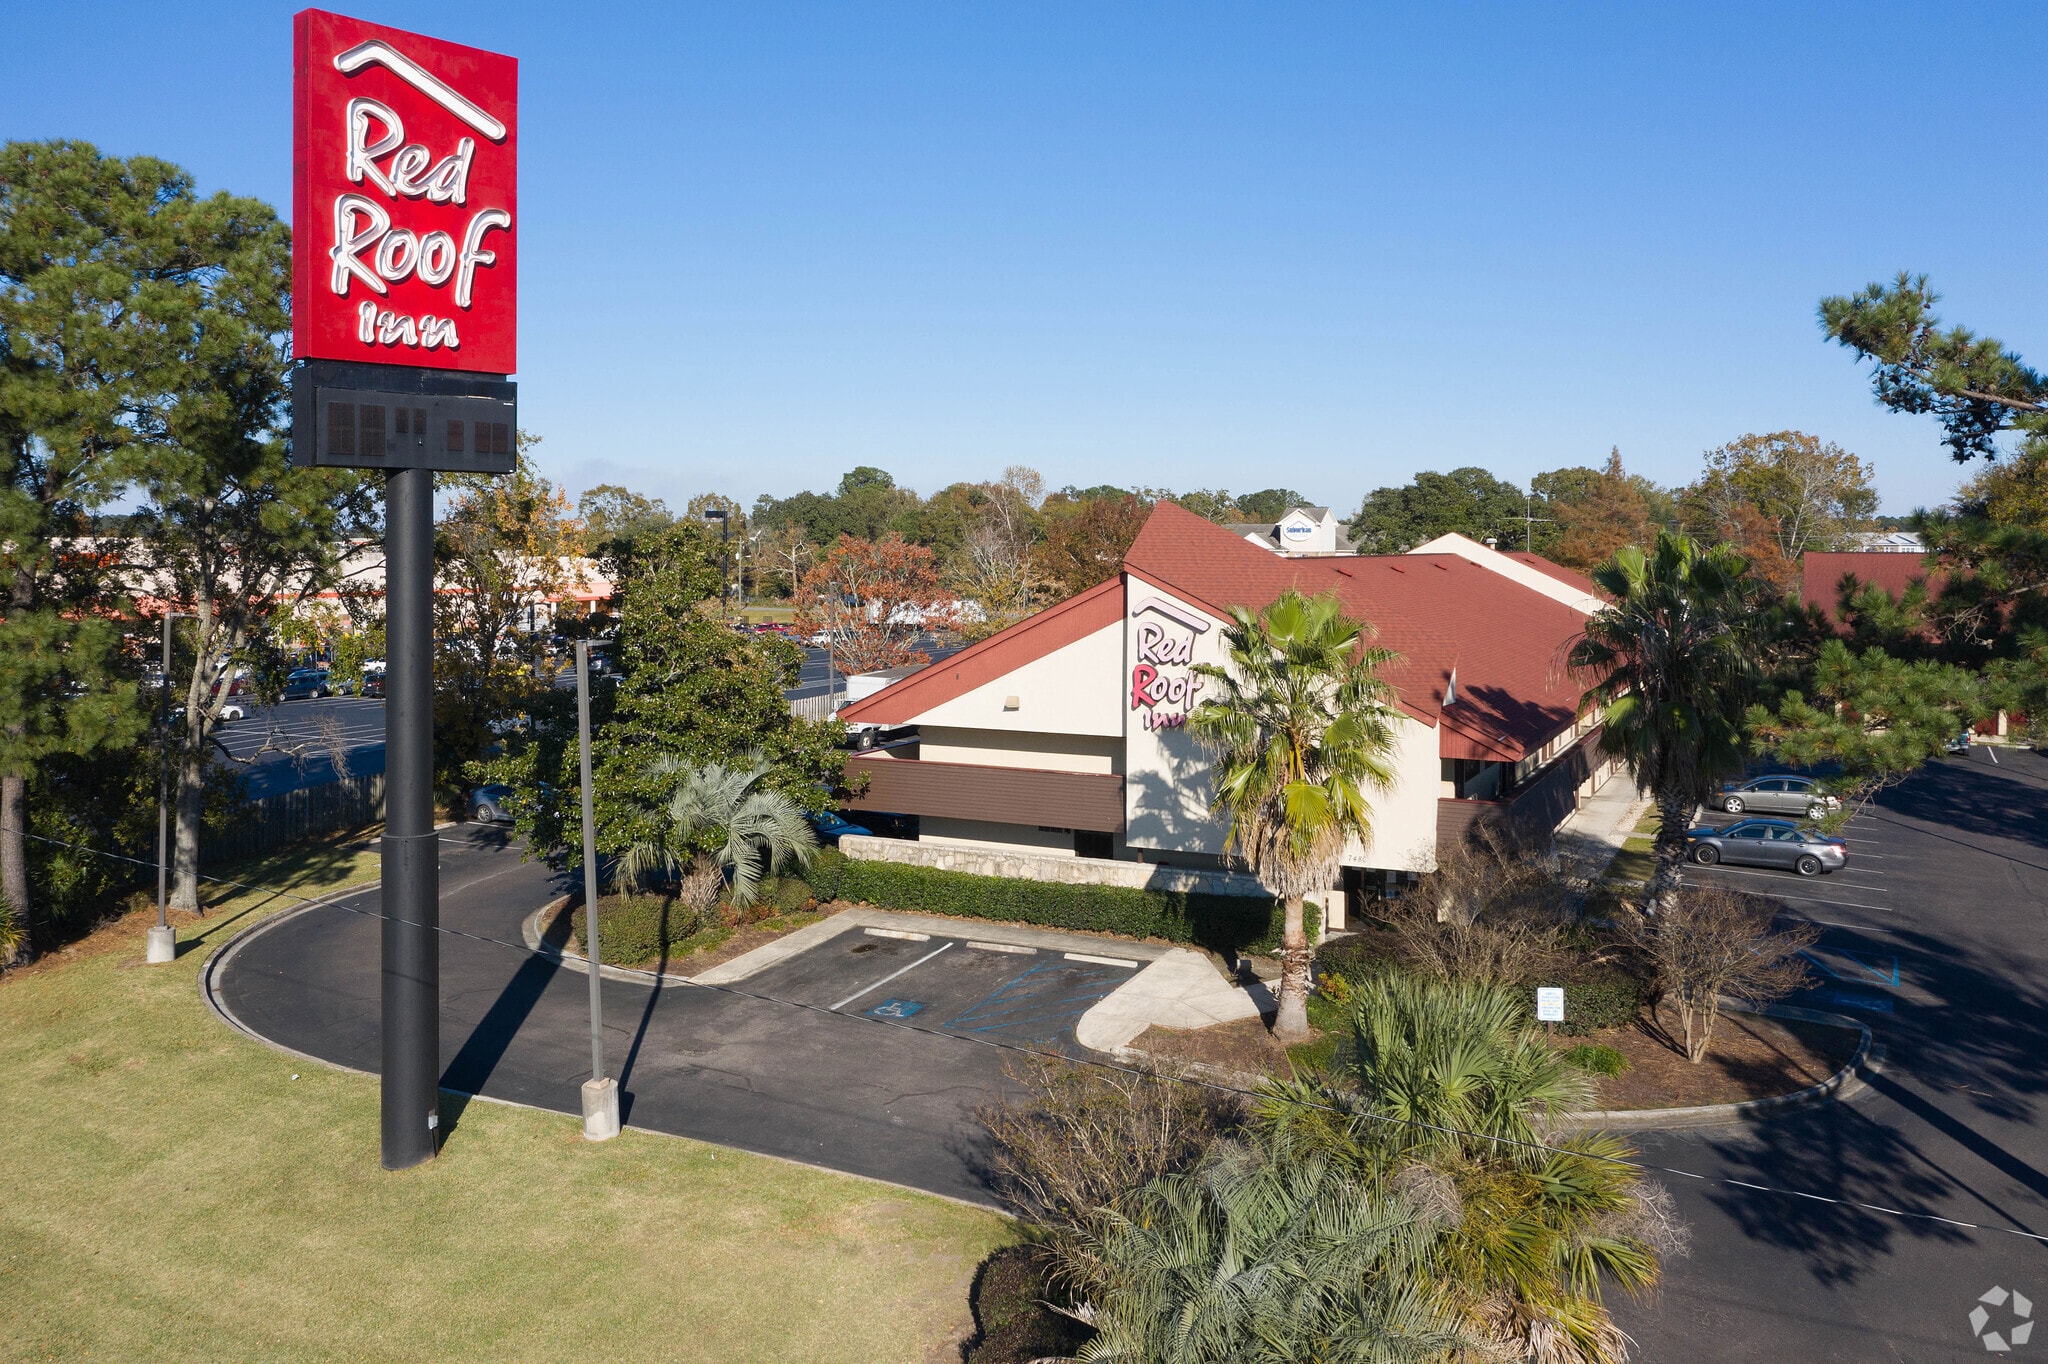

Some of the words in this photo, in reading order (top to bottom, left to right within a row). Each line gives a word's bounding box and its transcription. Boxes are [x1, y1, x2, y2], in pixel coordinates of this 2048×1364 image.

[346, 97, 475, 205] Red
[329, 194, 511, 309] Roof
[358, 301, 460, 347] Inn
[1138, 622, 1196, 666] Red
[1131, 664, 1204, 712] Roof
